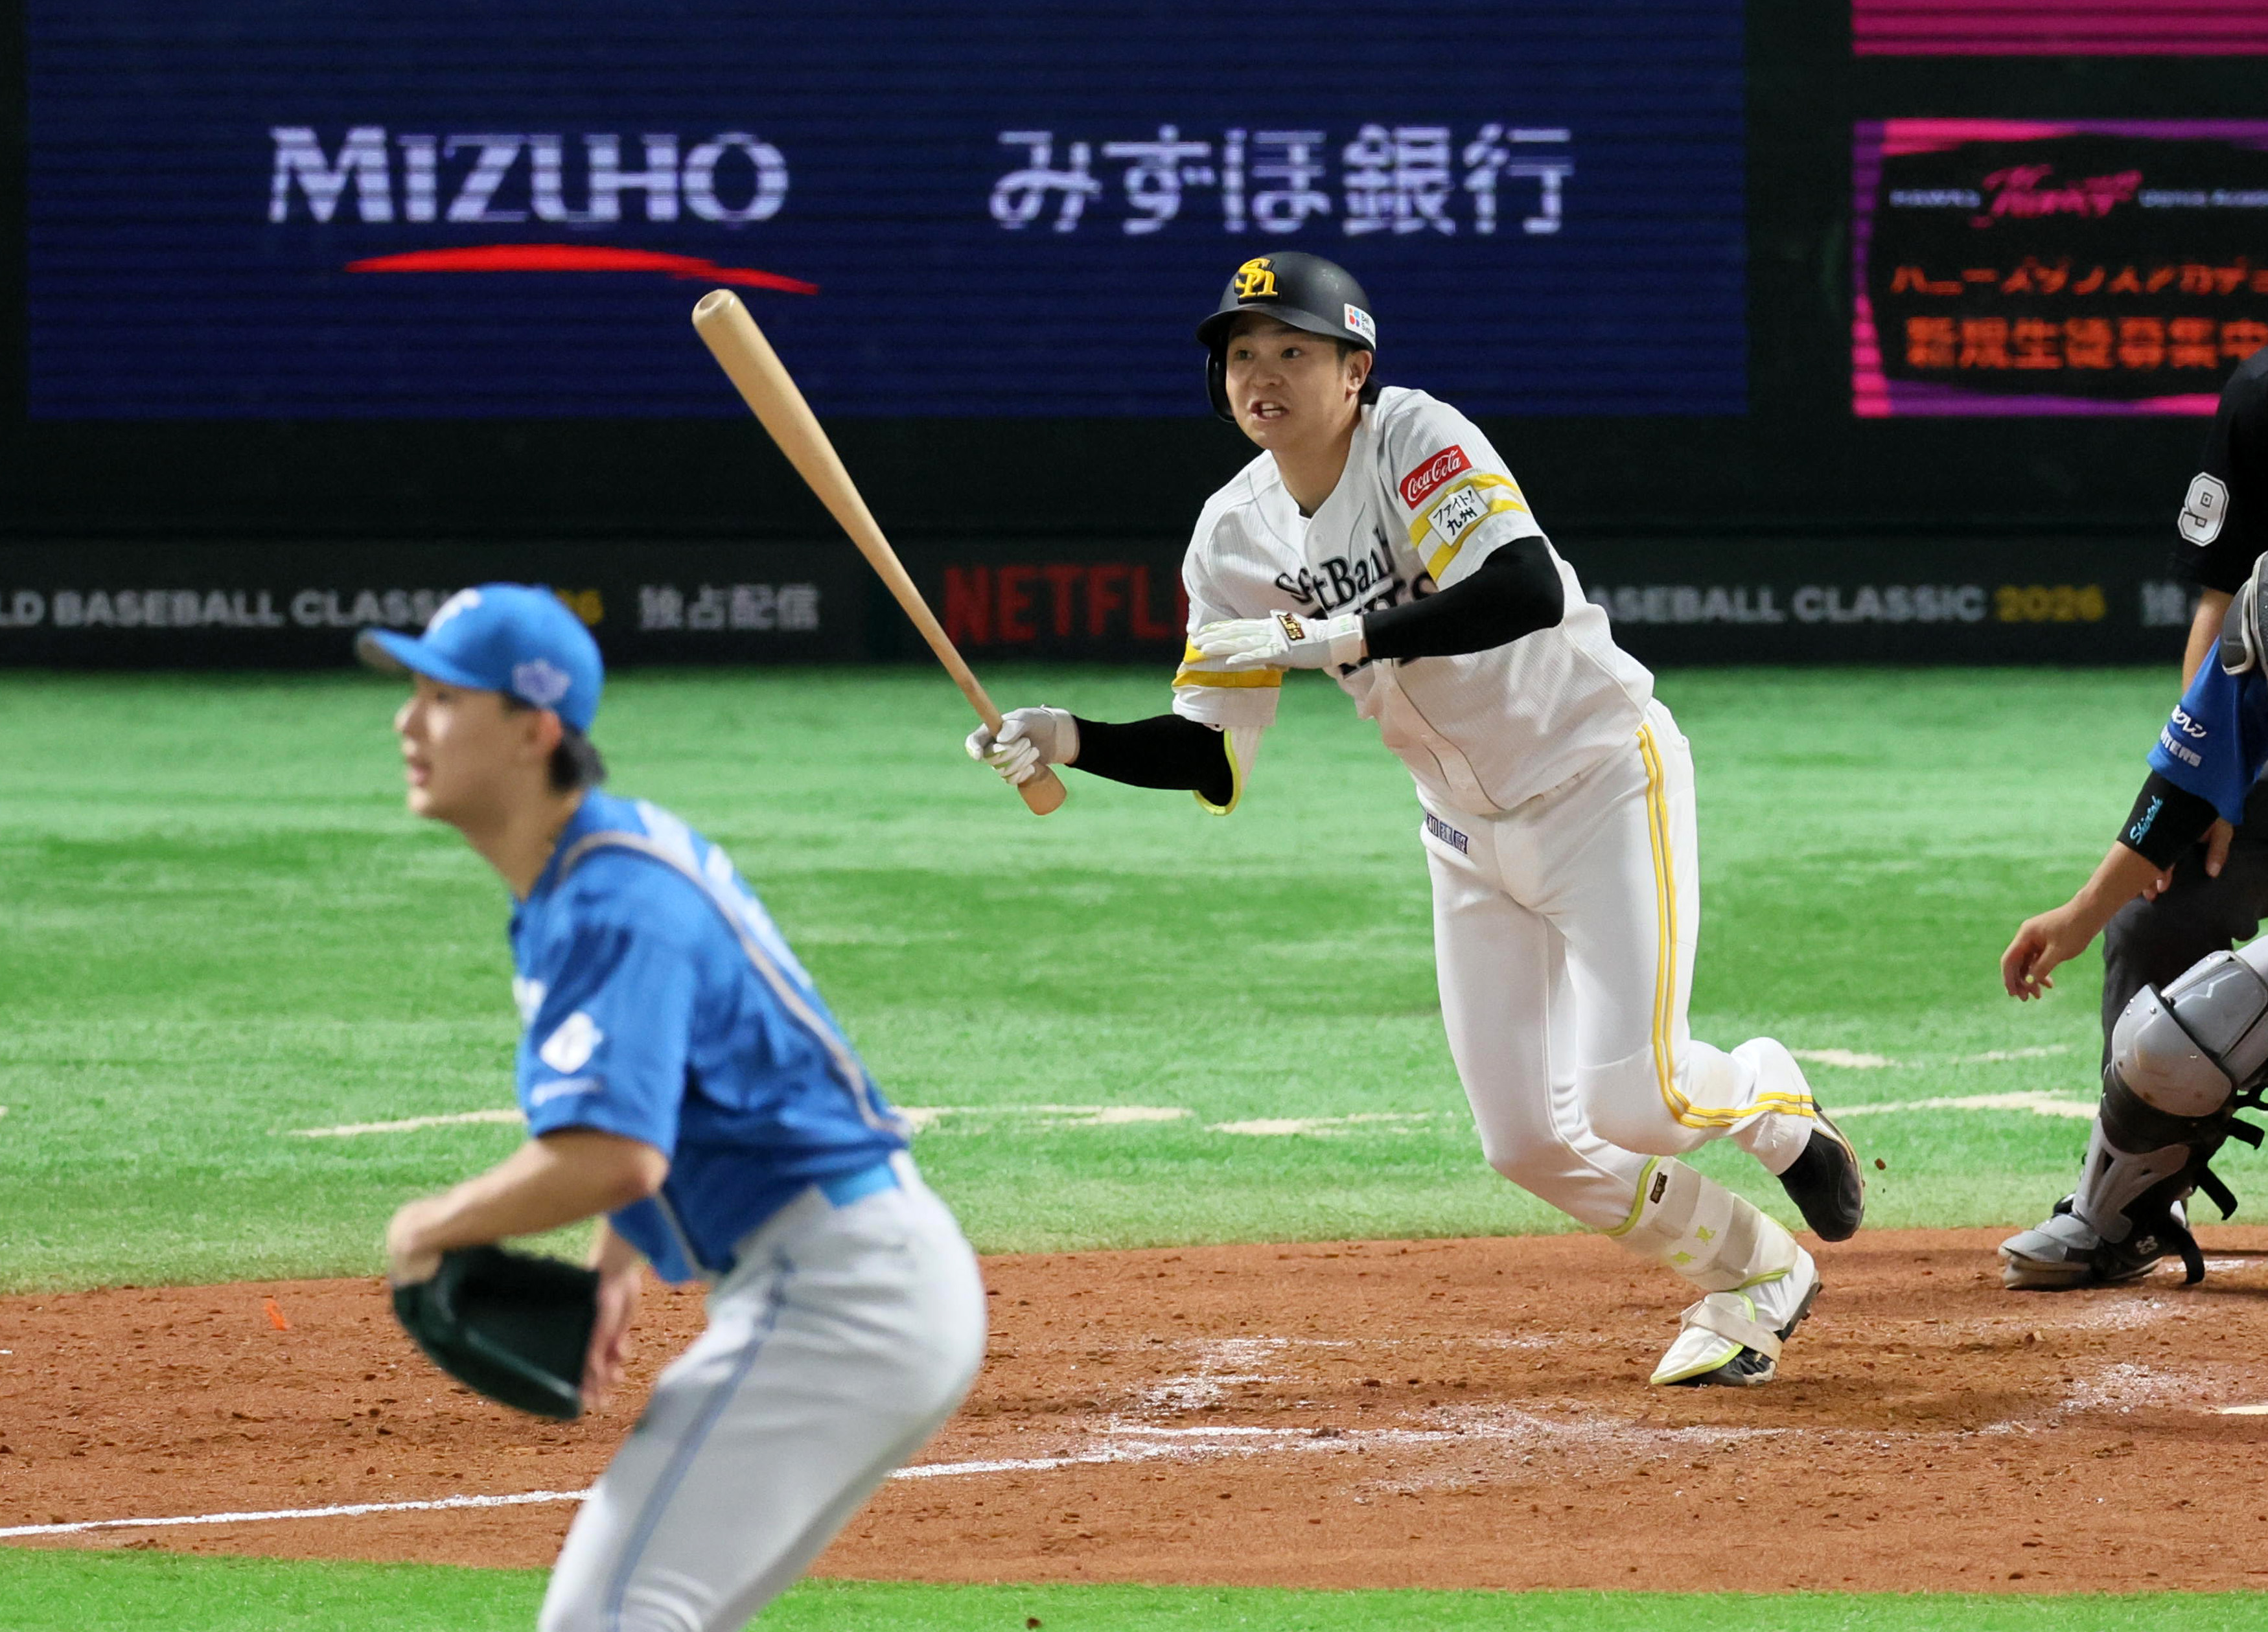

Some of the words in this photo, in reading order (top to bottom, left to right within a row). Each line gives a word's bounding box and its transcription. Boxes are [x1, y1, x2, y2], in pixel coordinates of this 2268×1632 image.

[268, 126, 789, 224] MIZUHO
[988, 124, 1573, 235] みずほ銀行
[1407, 449, 1461, 501] Coca-Cola
[1447, 507, 1477, 536] 九州
[2178, 472, 2229, 547] 9
[53, 589, 285, 628] BASEBALL
[290, 589, 452, 628] CLASS
[638, 584, 819, 630] 独占配信
[943, 564, 1188, 645] NETFL
[1588, 586, 1787, 624] ASEBALL
[1791, 585, 1987, 624] CLASSIC
[1995, 585, 2107, 623] 2026
